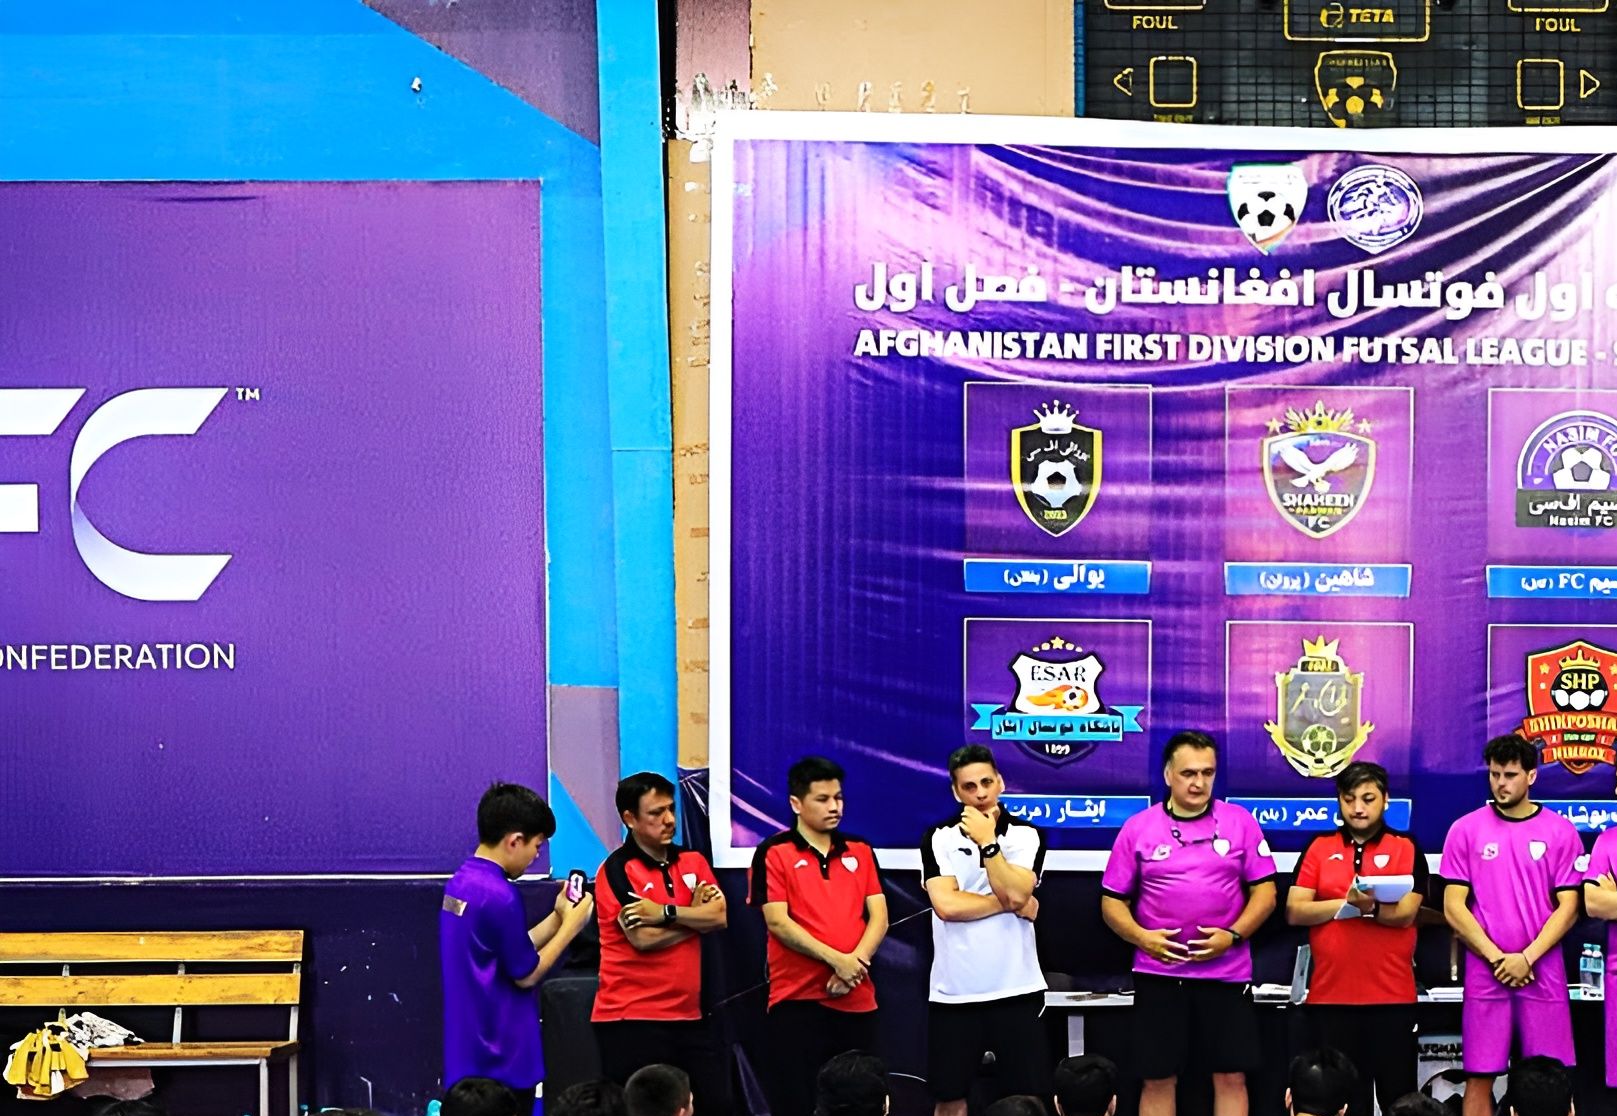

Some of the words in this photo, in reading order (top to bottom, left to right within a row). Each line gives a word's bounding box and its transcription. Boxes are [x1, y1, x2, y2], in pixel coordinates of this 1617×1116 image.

[1132, 15, 1179, 29] FOUL
[1349, 8, 1394, 23] TETA
[854, 260, 933, 313] اول
[946, 262, 1048, 313] فصل
[1085, 264, 1315, 315] افغانستان
[1327, 268, 1505, 322] فوتسال
[1515, 271, 1594, 320] اول
[854, 329, 1088, 361] AFGHANISTAN
[1096, 332, 1181, 362] FIRST
[1188, 334, 1335, 364] DIVISION
[1342, 337, 1459, 366] FUTSAL
[1466, 337, 1588, 367] LEAGUE
[1558, 572, 1586, 590] FC
[0, 642, 236, 670] NFEDERATION
[1031, 665, 1086, 682] ESAR
[1560, 672, 1600, 690] SHP
